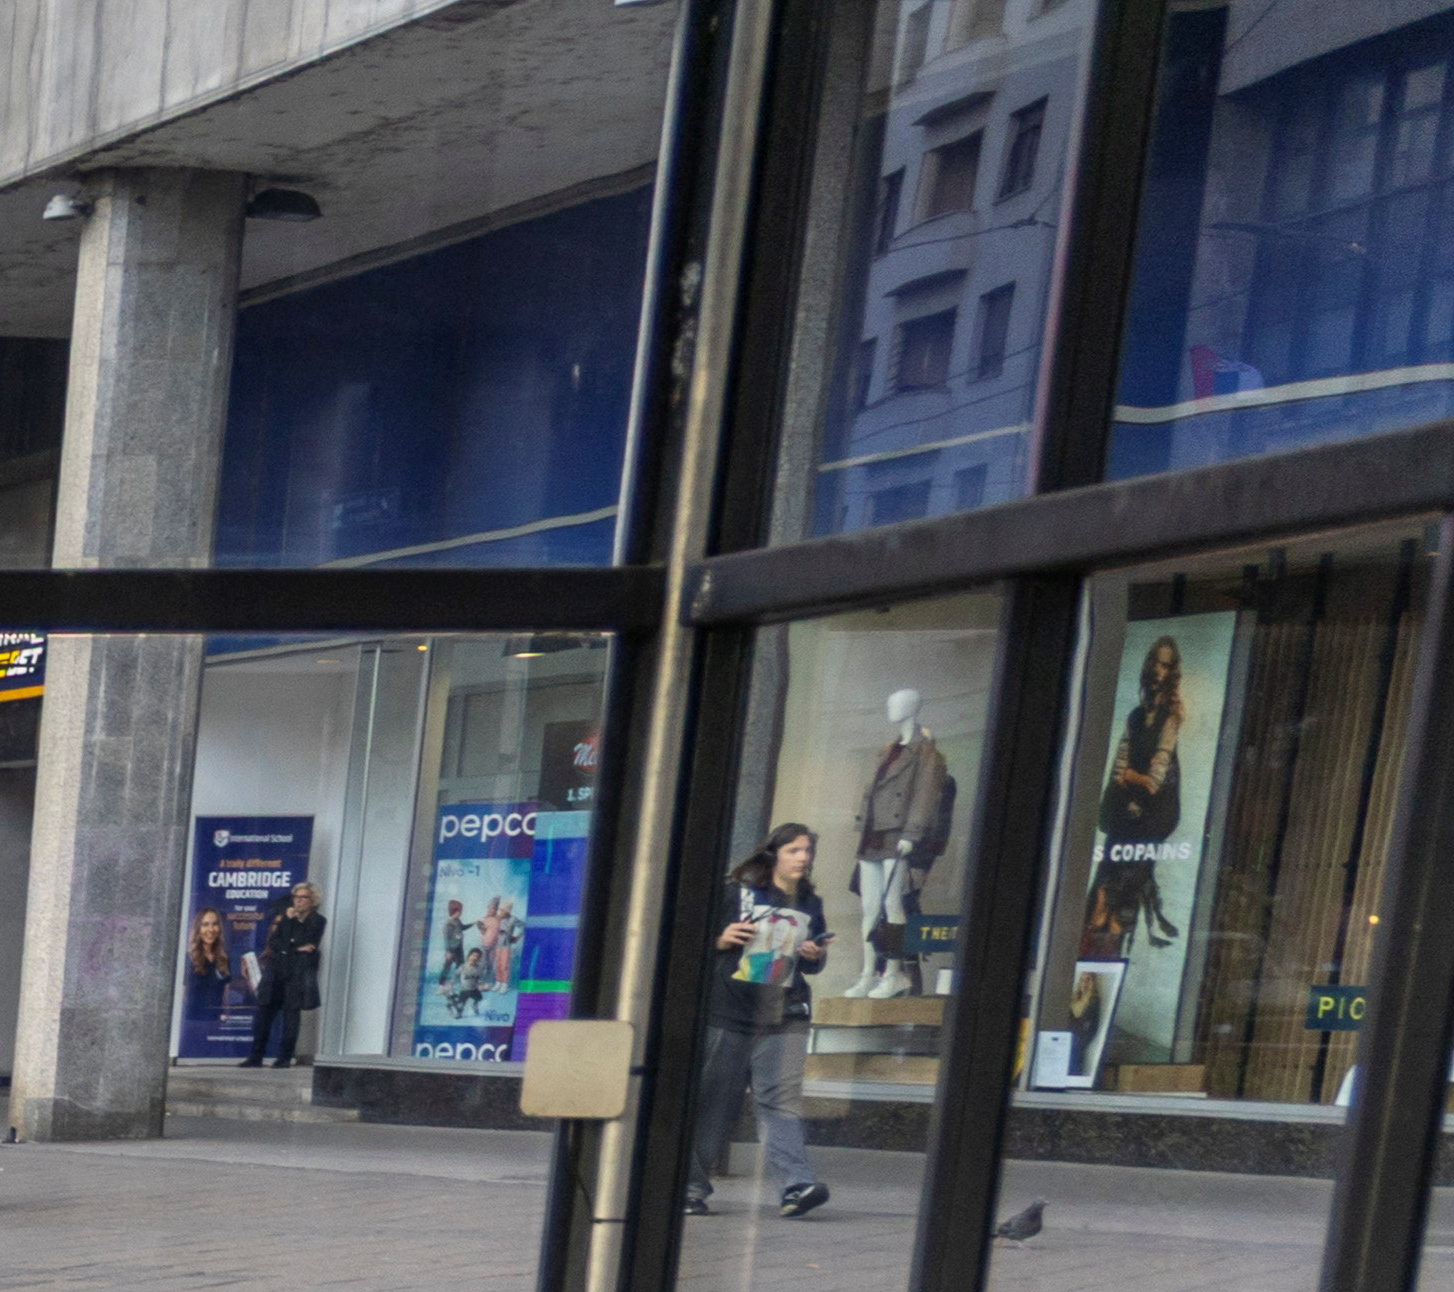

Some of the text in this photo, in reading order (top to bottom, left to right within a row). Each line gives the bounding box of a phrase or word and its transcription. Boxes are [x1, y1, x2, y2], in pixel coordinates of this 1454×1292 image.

[439, 812, 537, 844] pepco
[1110, 842, 1192, 862] COPAINS
[208, 871, 291, 888] CAMBRIDGE
